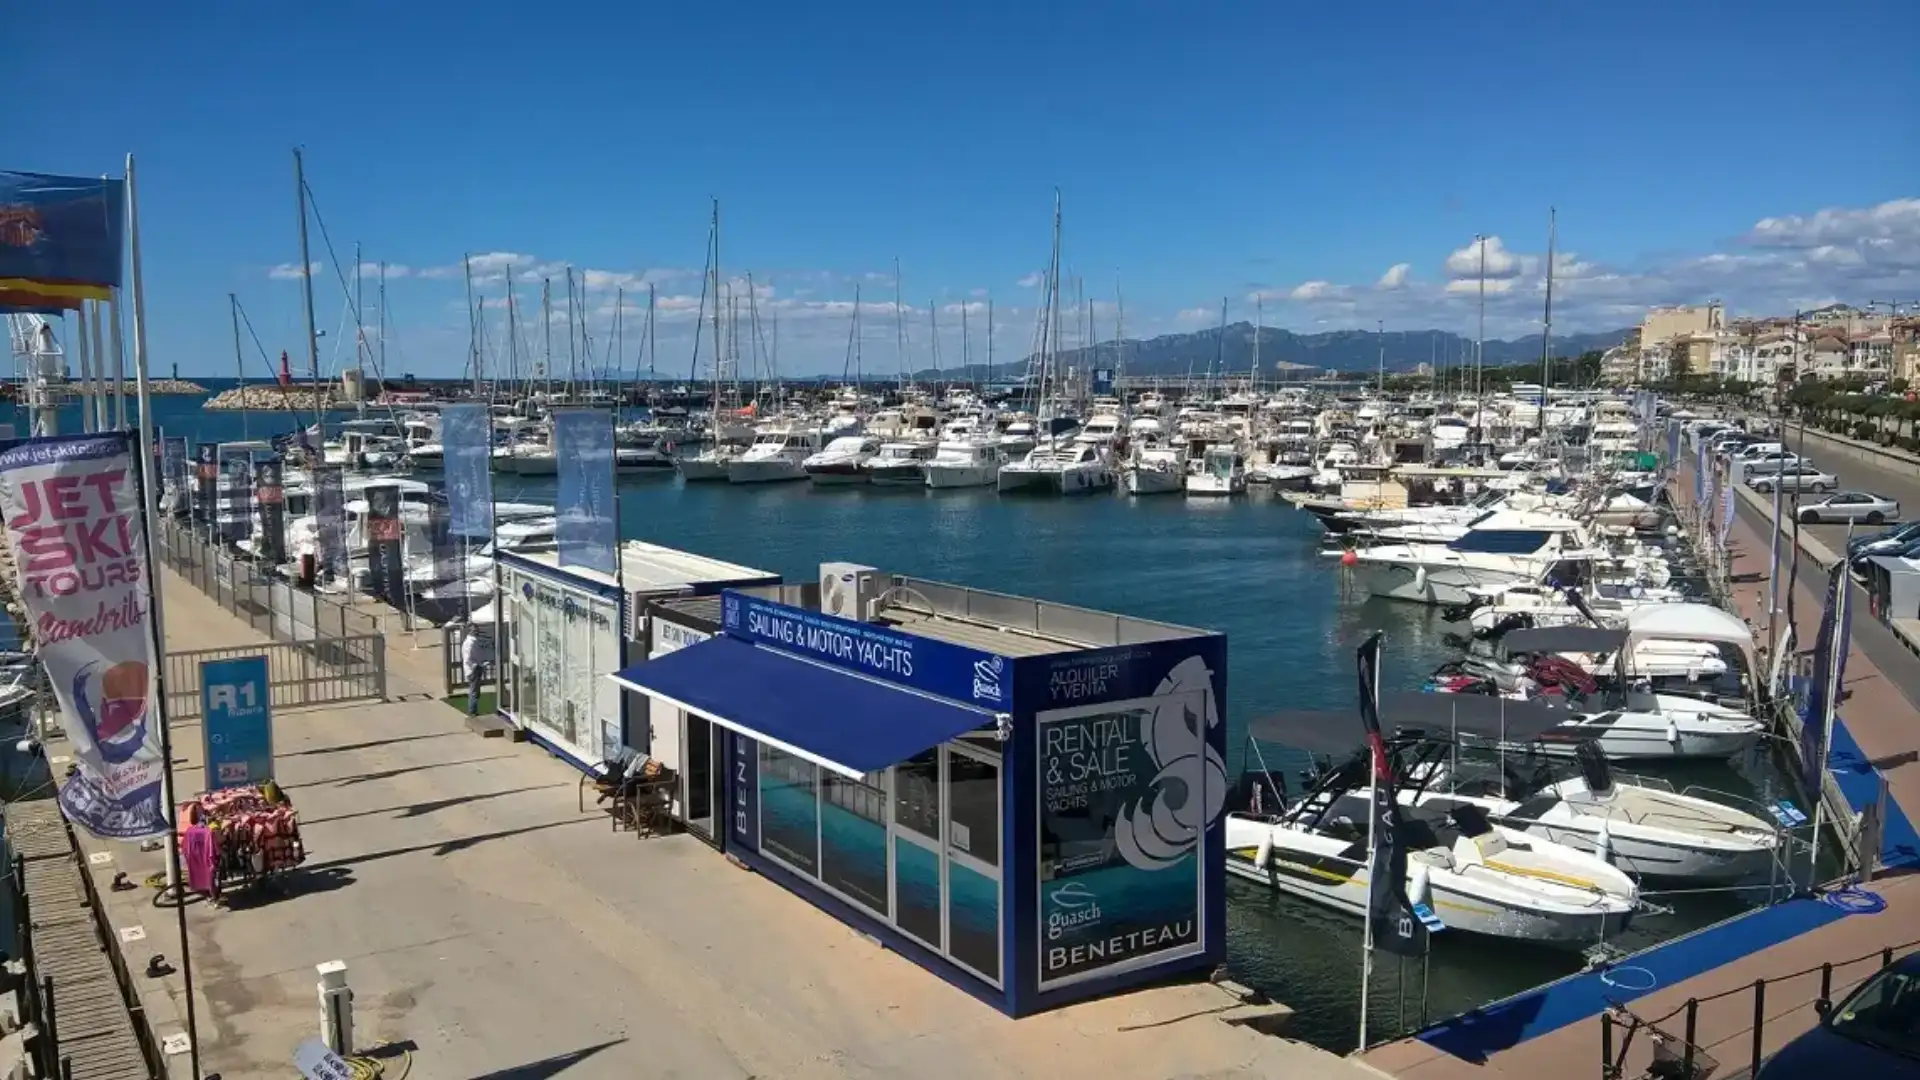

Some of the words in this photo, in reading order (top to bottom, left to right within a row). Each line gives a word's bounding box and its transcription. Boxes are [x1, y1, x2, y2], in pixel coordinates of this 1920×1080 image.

[8, 469, 127, 531] JET
[21, 515, 131, 572] SKI
[26, 558, 141, 598] TOURS
[37, 590, 148, 648] Cambrils
[748, 611, 794, 644] SAILING
[796, 624, 806, 647] &
[807, 626, 853, 661] MOTOR
[856, 639, 913, 677] YACHTS
[1050, 664, 1119, 685] ALQUILER
[1051, 687, 1061, 700] Y
[1063, 680, 1108, 700] VENTA
[208, 680, 256, 711] R1
[1046, 716, 1137, 756] RENTAL
[1046, 756, 1065, 785] &
[1069, 745, 1131, 782] SALE
[1046, 782, 1088, 801] SAILING
[1091, 780, 1098, 793] &
[1100, 774, 1137, 791] MOTOR
[1046, 797, 1089, 813] YACHTS
[1048, 901, 1101, 940] guasch
[1049, 919, 1192, 971] BENETEAU
